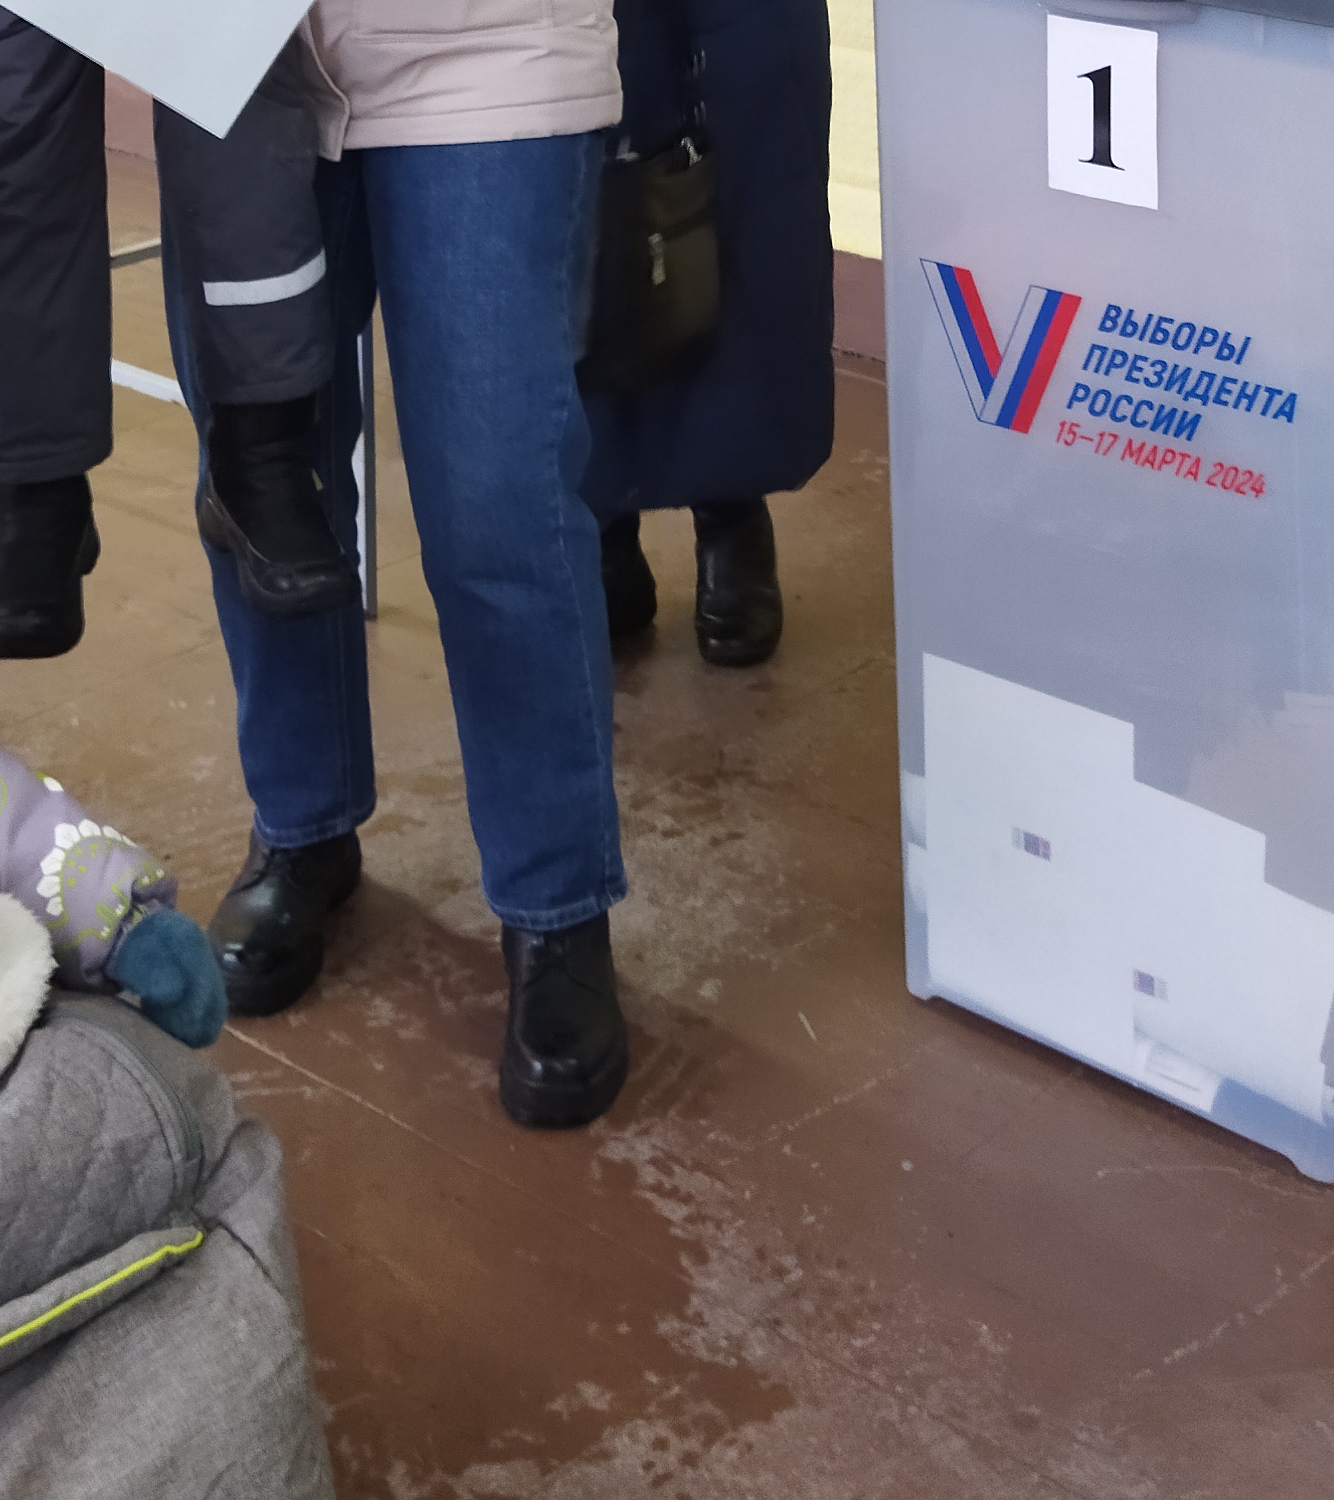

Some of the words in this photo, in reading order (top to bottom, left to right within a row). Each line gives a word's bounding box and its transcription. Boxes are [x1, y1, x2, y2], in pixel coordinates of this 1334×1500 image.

[1076, 64, 1126, 172] 1
[1097, 302, 1253, 366] ВЫБОРЫ
[1066, 381, 1203, 442] РОССИИ
[1081, 343, 1299, 424] ПРЕЗИДЕНТА
[1120, 438, 1202, 482] МАРТА
[1204, 461, 1267, 500] 2024
